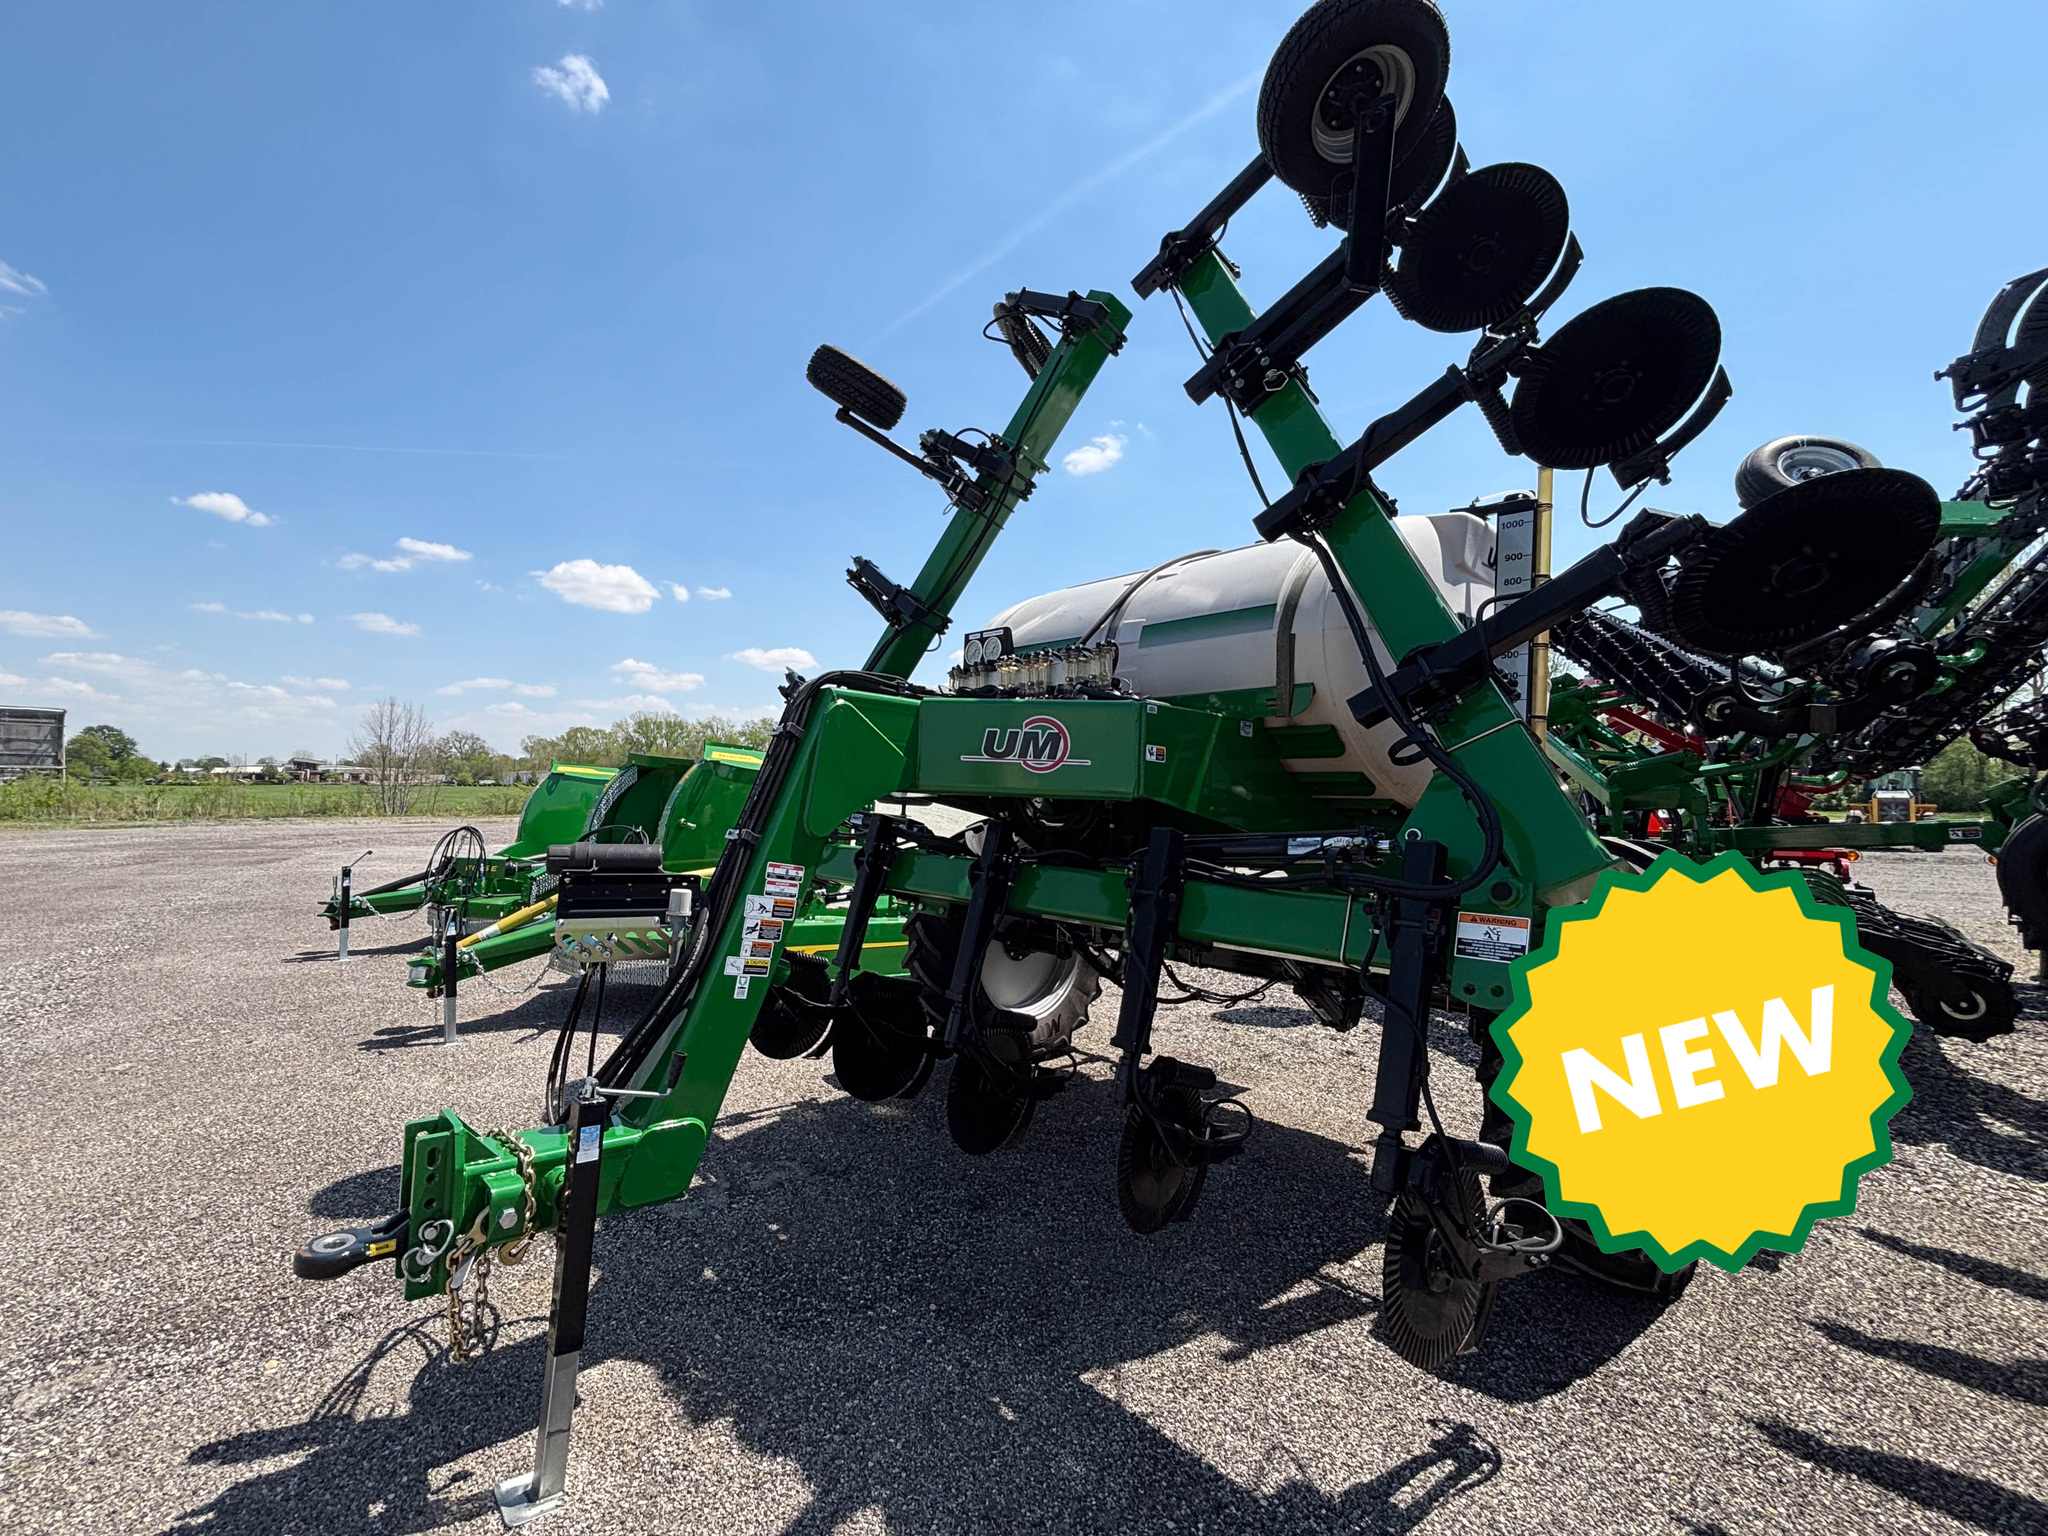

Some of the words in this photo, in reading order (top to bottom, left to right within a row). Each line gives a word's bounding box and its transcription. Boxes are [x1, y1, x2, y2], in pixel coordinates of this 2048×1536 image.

[1501, 519, 1524, 530] 1000
[1504, 552, 1523, 562] 900
[1503, 577, 1522, 586] 800
[982, 728, 1062, 760] UM
[1479, 916, 1517, 926] WARNING
